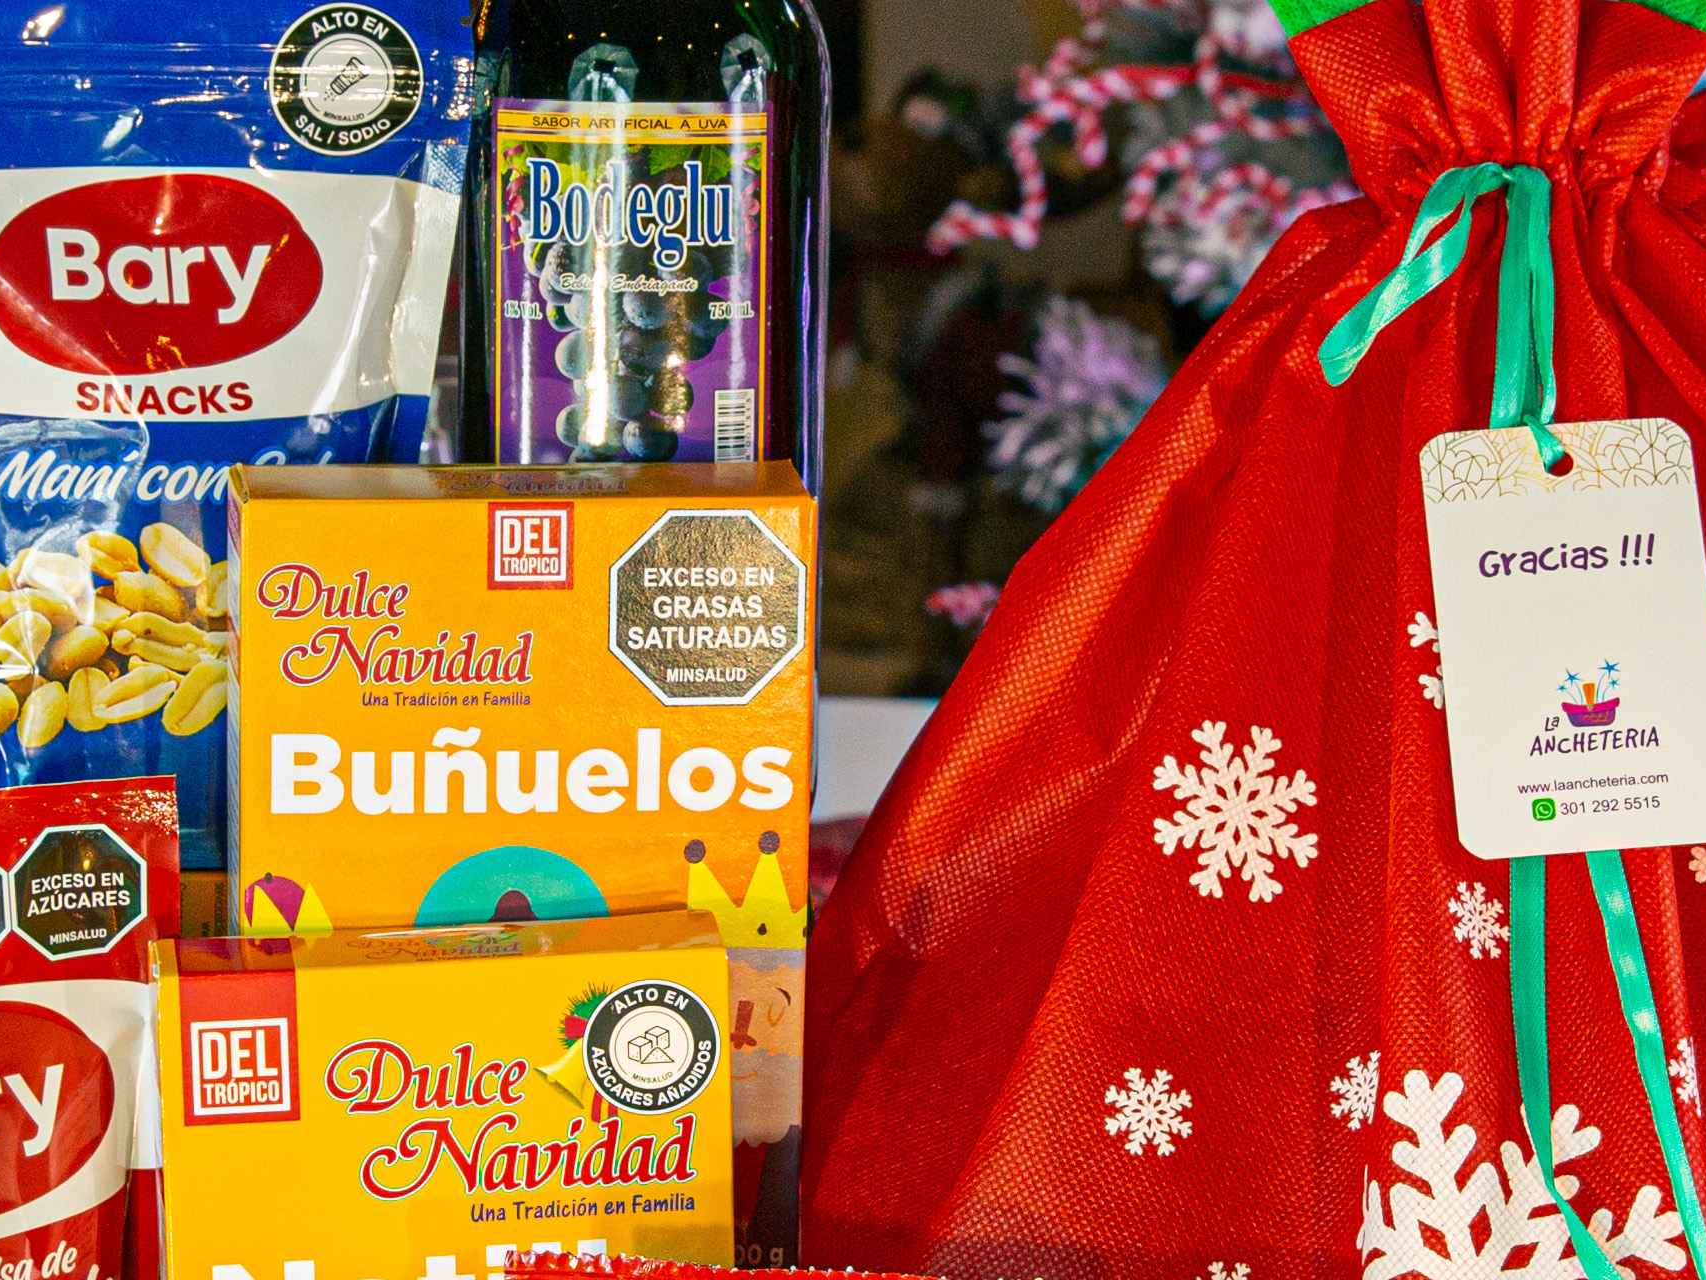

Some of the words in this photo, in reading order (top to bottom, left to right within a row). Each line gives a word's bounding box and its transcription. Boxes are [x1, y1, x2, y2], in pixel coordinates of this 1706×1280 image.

[311, 11, 358, 39] ALTO
[362, 16, 389, 40] EN
[295, 115, 323, 142] SAL
[338, 118, 391, 146] SODIO
[323, 110, 365, 122] MINSALUD
[532, 116, 581, 128] SABOR
[588, 118, 673, 130] ARTIFICIAL
[680, 119, 690, 130] A
[698, 119, 728, 130] UVA
[527, 157, 734, 270] Bodeglu
[45, 227, 271, 324] Bary
[611, 273, 698, 296] Embriagante
[709, 302, 732, 318] 750
[76, 381, 253, 416] SNACKS
[139, 463, 229, 501] con
[502, 517, 558, 555] DEL
[502, 554, 560, 575] TRÓPICO
[1479, 542, 1608, 578] Gracias
[1620, 533, 1654, 567] !!!
[257, 562, 410, 620] Dulce
[644, 567, 738, 587] EXCESO
[745, 567, 775, 587] EN
[653, 596, 763, 619] GRASAS
[627, 626, 787, 649] SATURADAS
[280, 624, 534, 685] Navidad
[666, 668, 747, 683] MINSALUD
[362, 691, 388, 707] Una
[394, 691, 458, 707] Tradición
[461, 696, 478, 706] en
[483, 691, 530, 707] Familia
[1544, 715, 1560, 732] La
[1530, 726, 1659, 757] ANCHETERIA
[271, 726, 793, 815] Buñuelos
[1517, 771, 1669, 794] www.laancheteria.com
[1560, 801, 1587, 816] 301
[1592, 799, 1619, 814] 292
[1624, 796, 1660, 812] 5515
[31, 875, 95, 896] EXCESO
[100, 871, 124, 888] EN
[27, 887, 131, 917] AZÚCARES
[49, 926, 107, 945] MINSALUD
[614, 988, 659, 1014] ALTO
[664, 990, 689, 1011] EN
[202, 1030, 276, 1078] DEL
[324, 1037, 529, 1114] Dulce
[592, 1046, 653, 1106] AZÚCARES
[657, 1040, 712, 1106] AÑADIDOS
[632, 1072, 673, 1084] MINSALUD
[203, 1077, 280, 1103] TRÓPICO
[360, 1112, 698, 1201] Navidad
[471, 1203, 506, 1224] Una
[512, 1199, 598, 1221] Tradición
[604, 1201, 625, 1215] en
[631, 1193, 696, 1214] Familia
[41, 1240, 78, 1279] de
